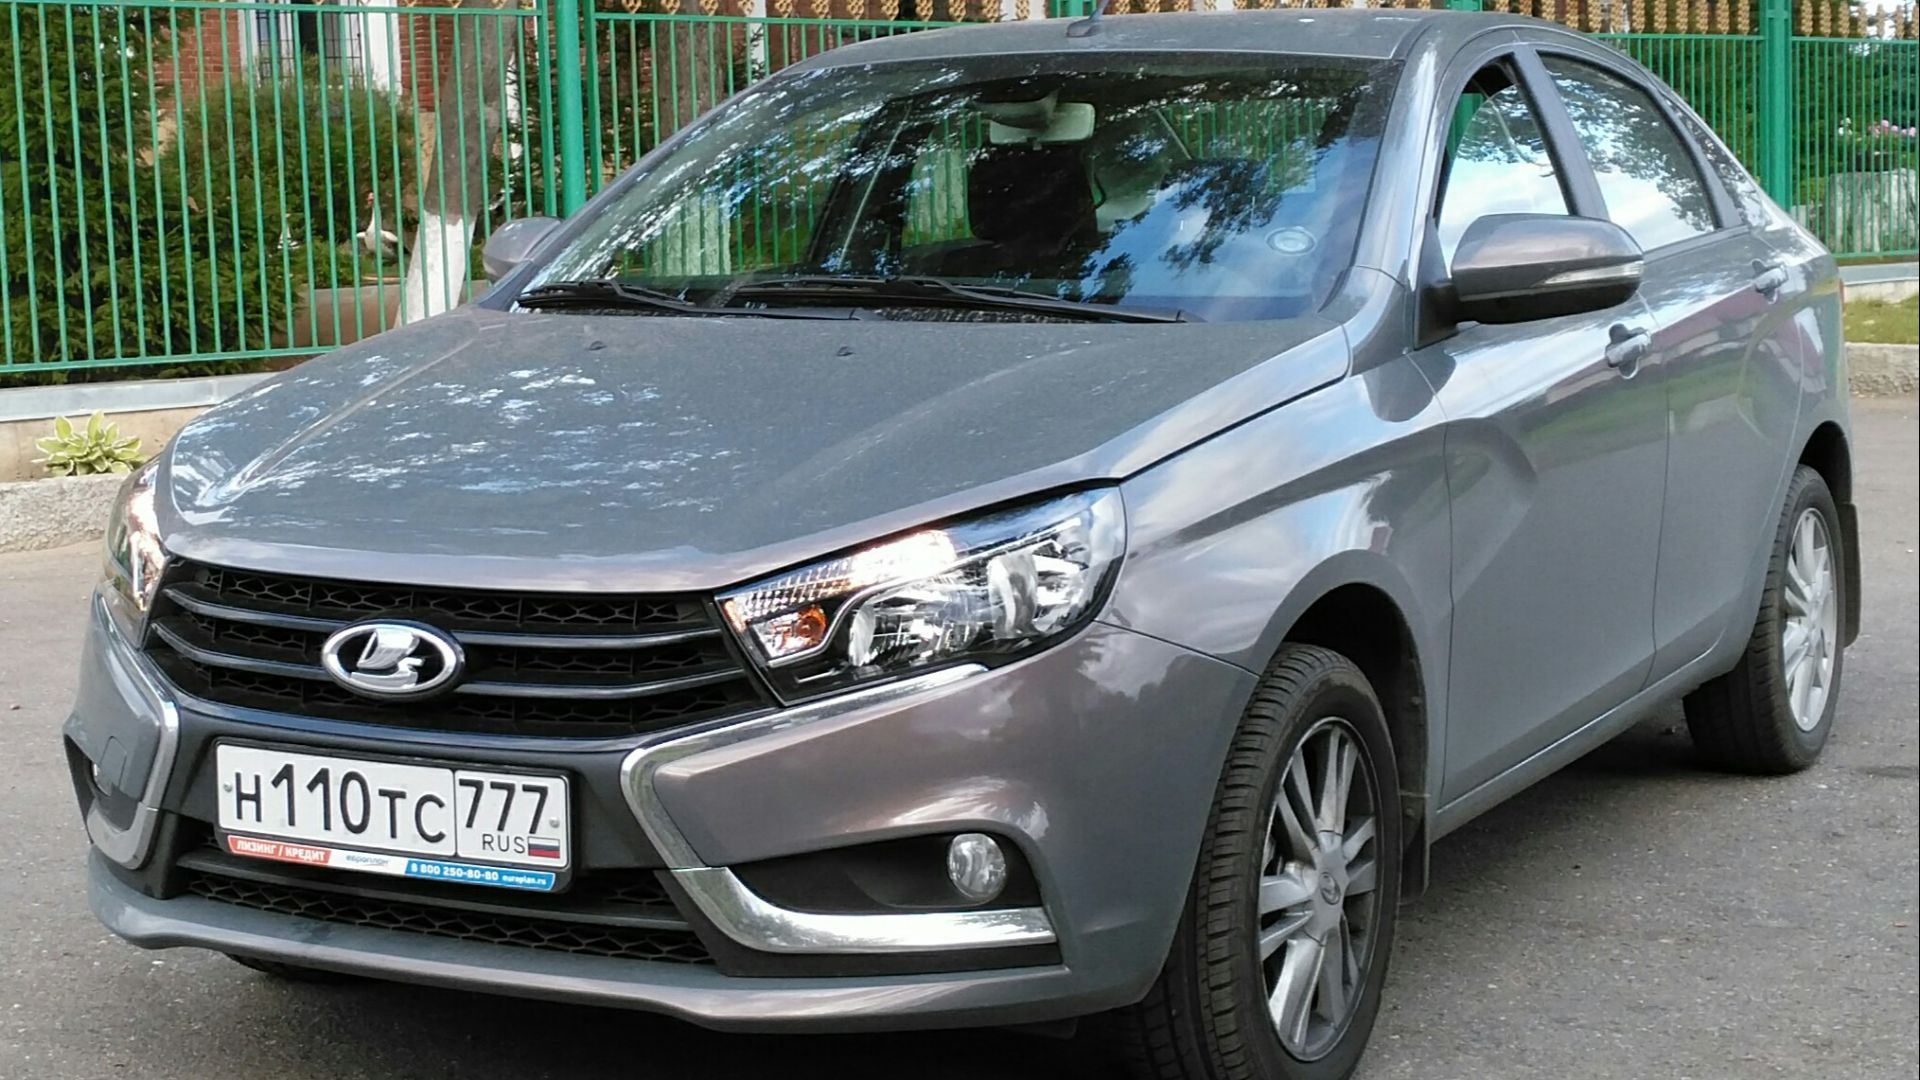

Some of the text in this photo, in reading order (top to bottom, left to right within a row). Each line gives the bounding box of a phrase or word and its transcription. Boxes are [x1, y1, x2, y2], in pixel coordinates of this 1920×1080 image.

[458, 778, 549, 834] 777
[237, 840, 276, 855] ЛИЗИНГ
[285, 846, 327, 862] КРЕДИТ
[481, 833, 526, 854] RUS
[411, 862, 547, 886] 8 800 250-80-80 europlan.ru
